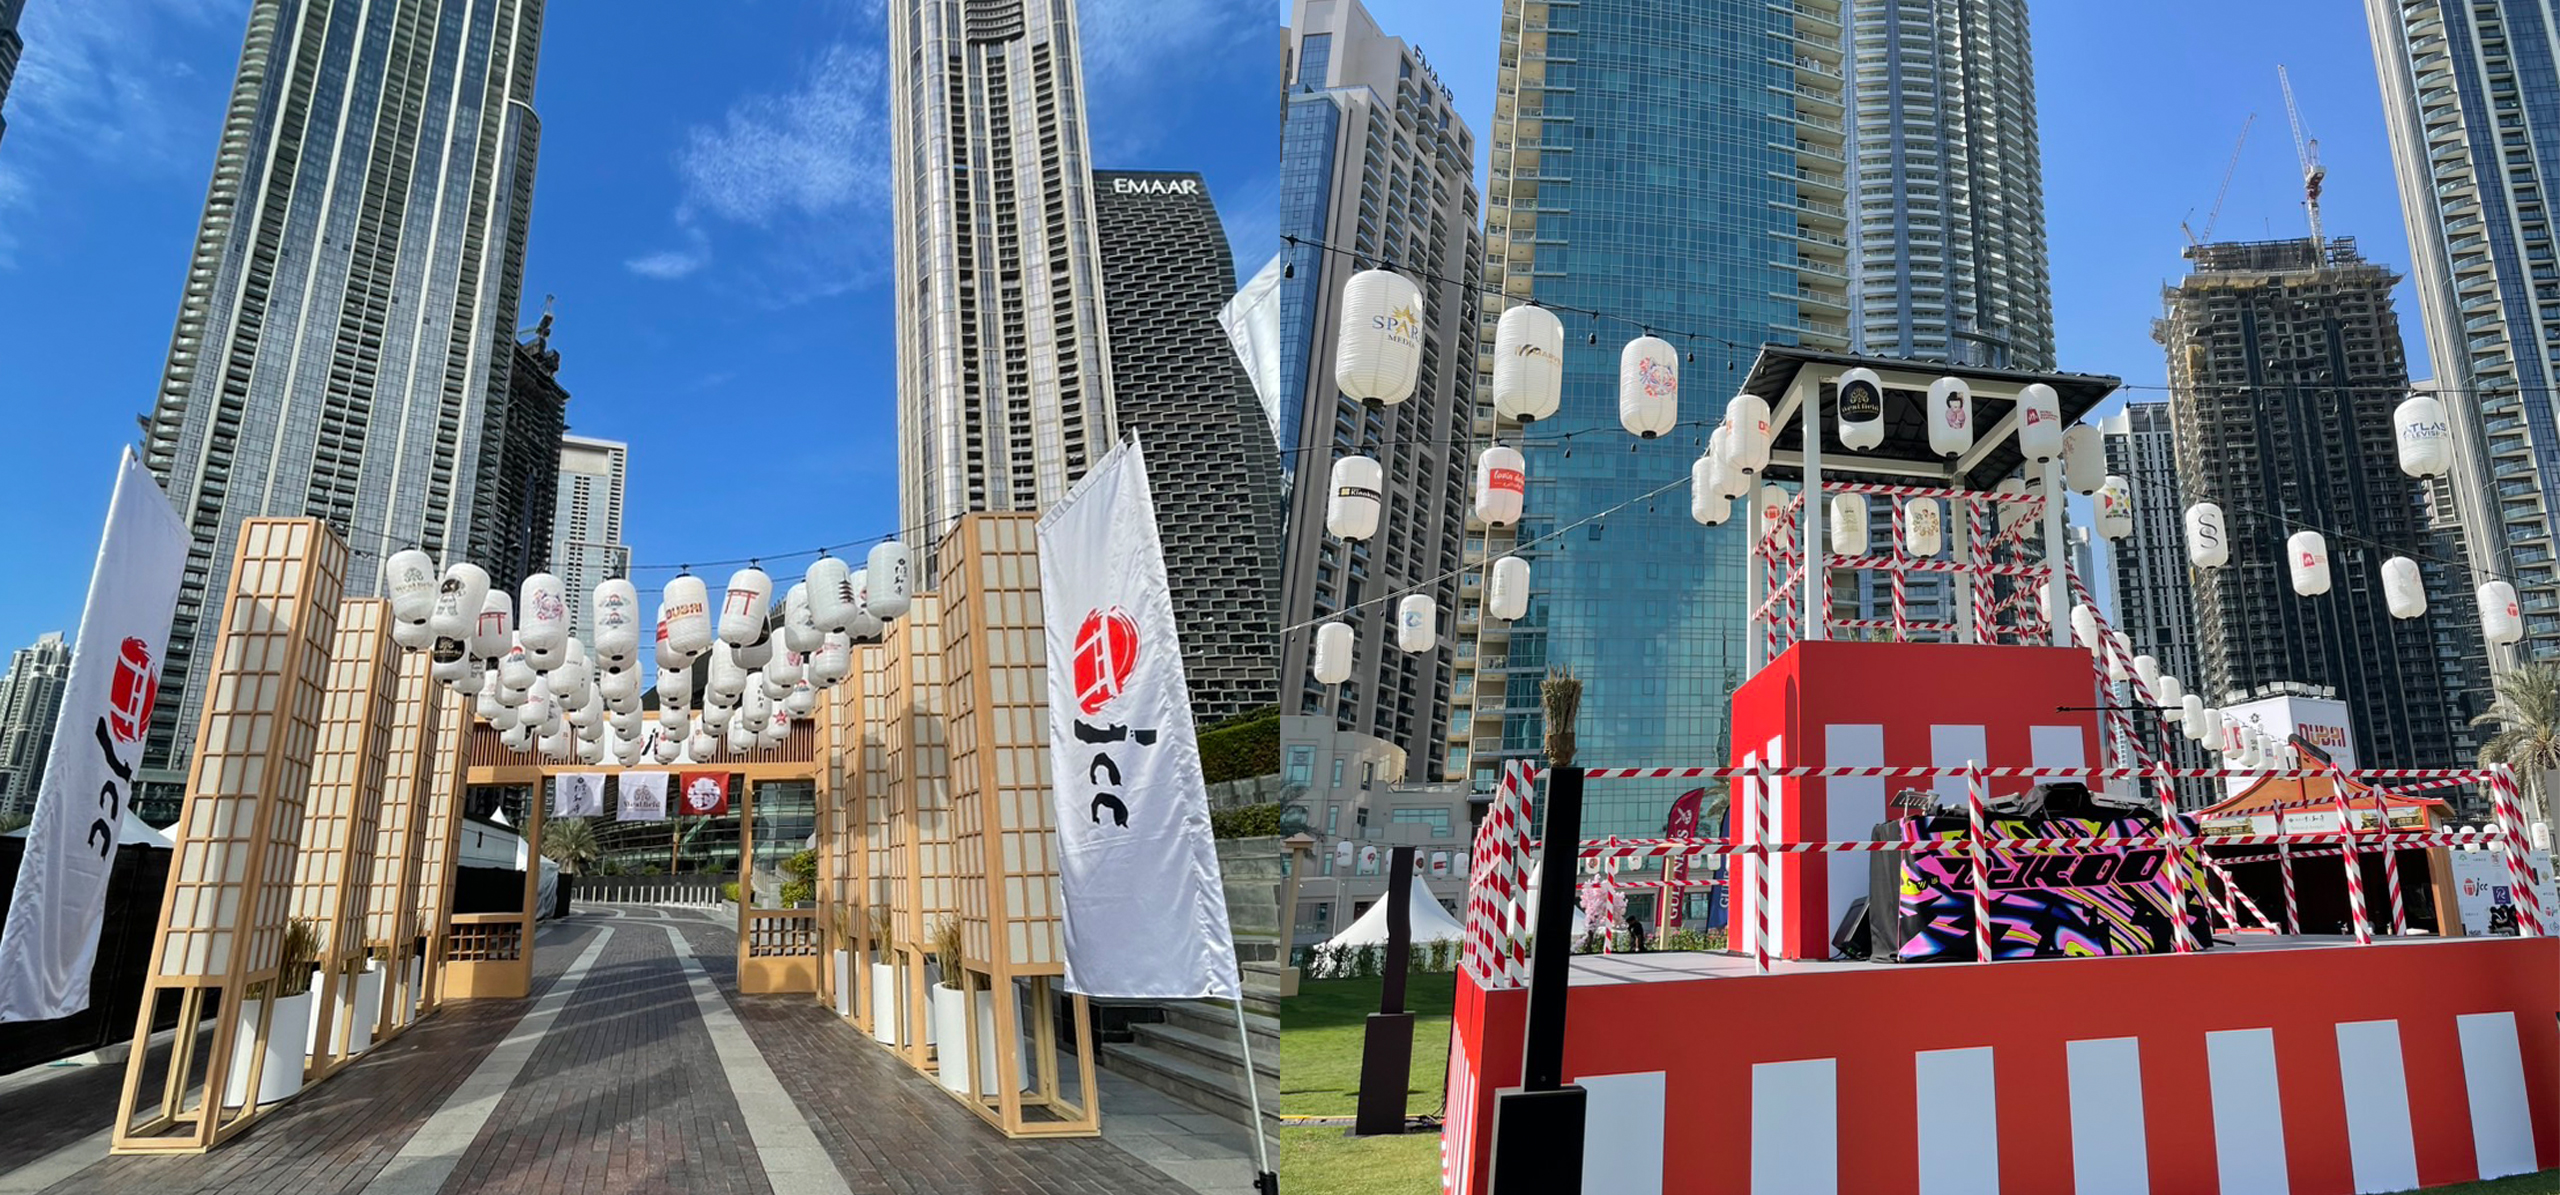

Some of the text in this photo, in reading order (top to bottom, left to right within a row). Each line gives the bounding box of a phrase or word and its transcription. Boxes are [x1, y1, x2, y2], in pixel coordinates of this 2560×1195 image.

[1414, 44, 1454, 107] EMAAR
[1113, 178, 1199, 195] EMAAR
[1388, 334, 1416, 348] MEDIA
[1073, 718, 1158, 829] jcc
[2475, 877, 2489, 898] jcc
